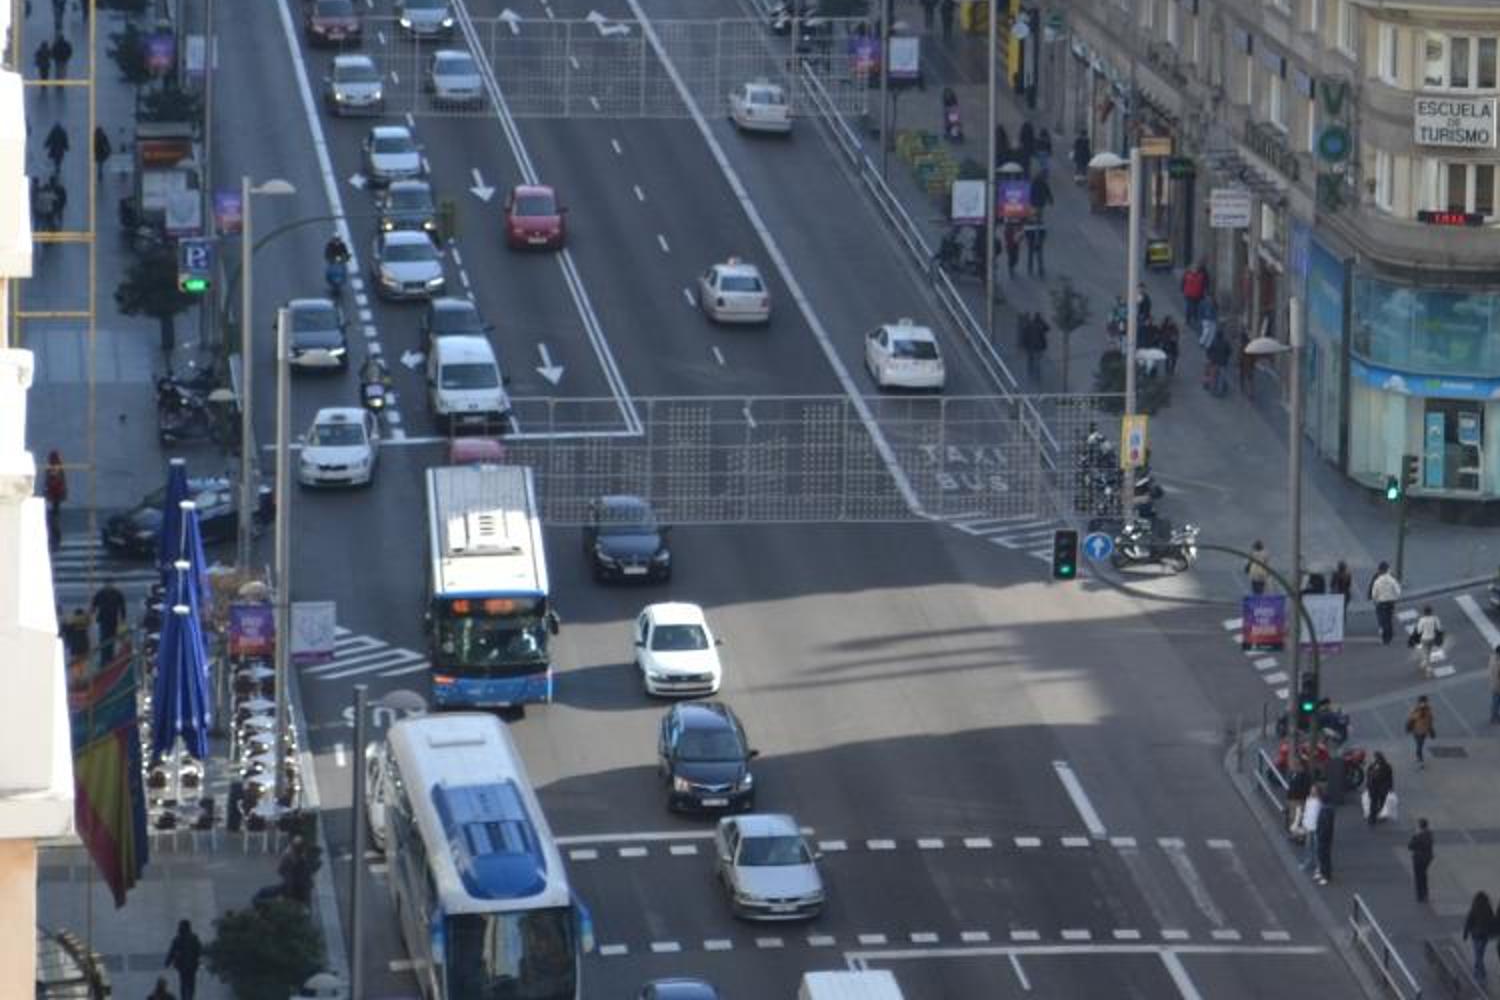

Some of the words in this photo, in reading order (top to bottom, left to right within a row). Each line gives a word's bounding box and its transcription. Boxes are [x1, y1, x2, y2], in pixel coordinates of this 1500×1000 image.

[1418, 101, 1491, 118] ESCUELA
[1420, 127, 1489, 144] TURISMO
[936, 471, 1008, 491] BUS
